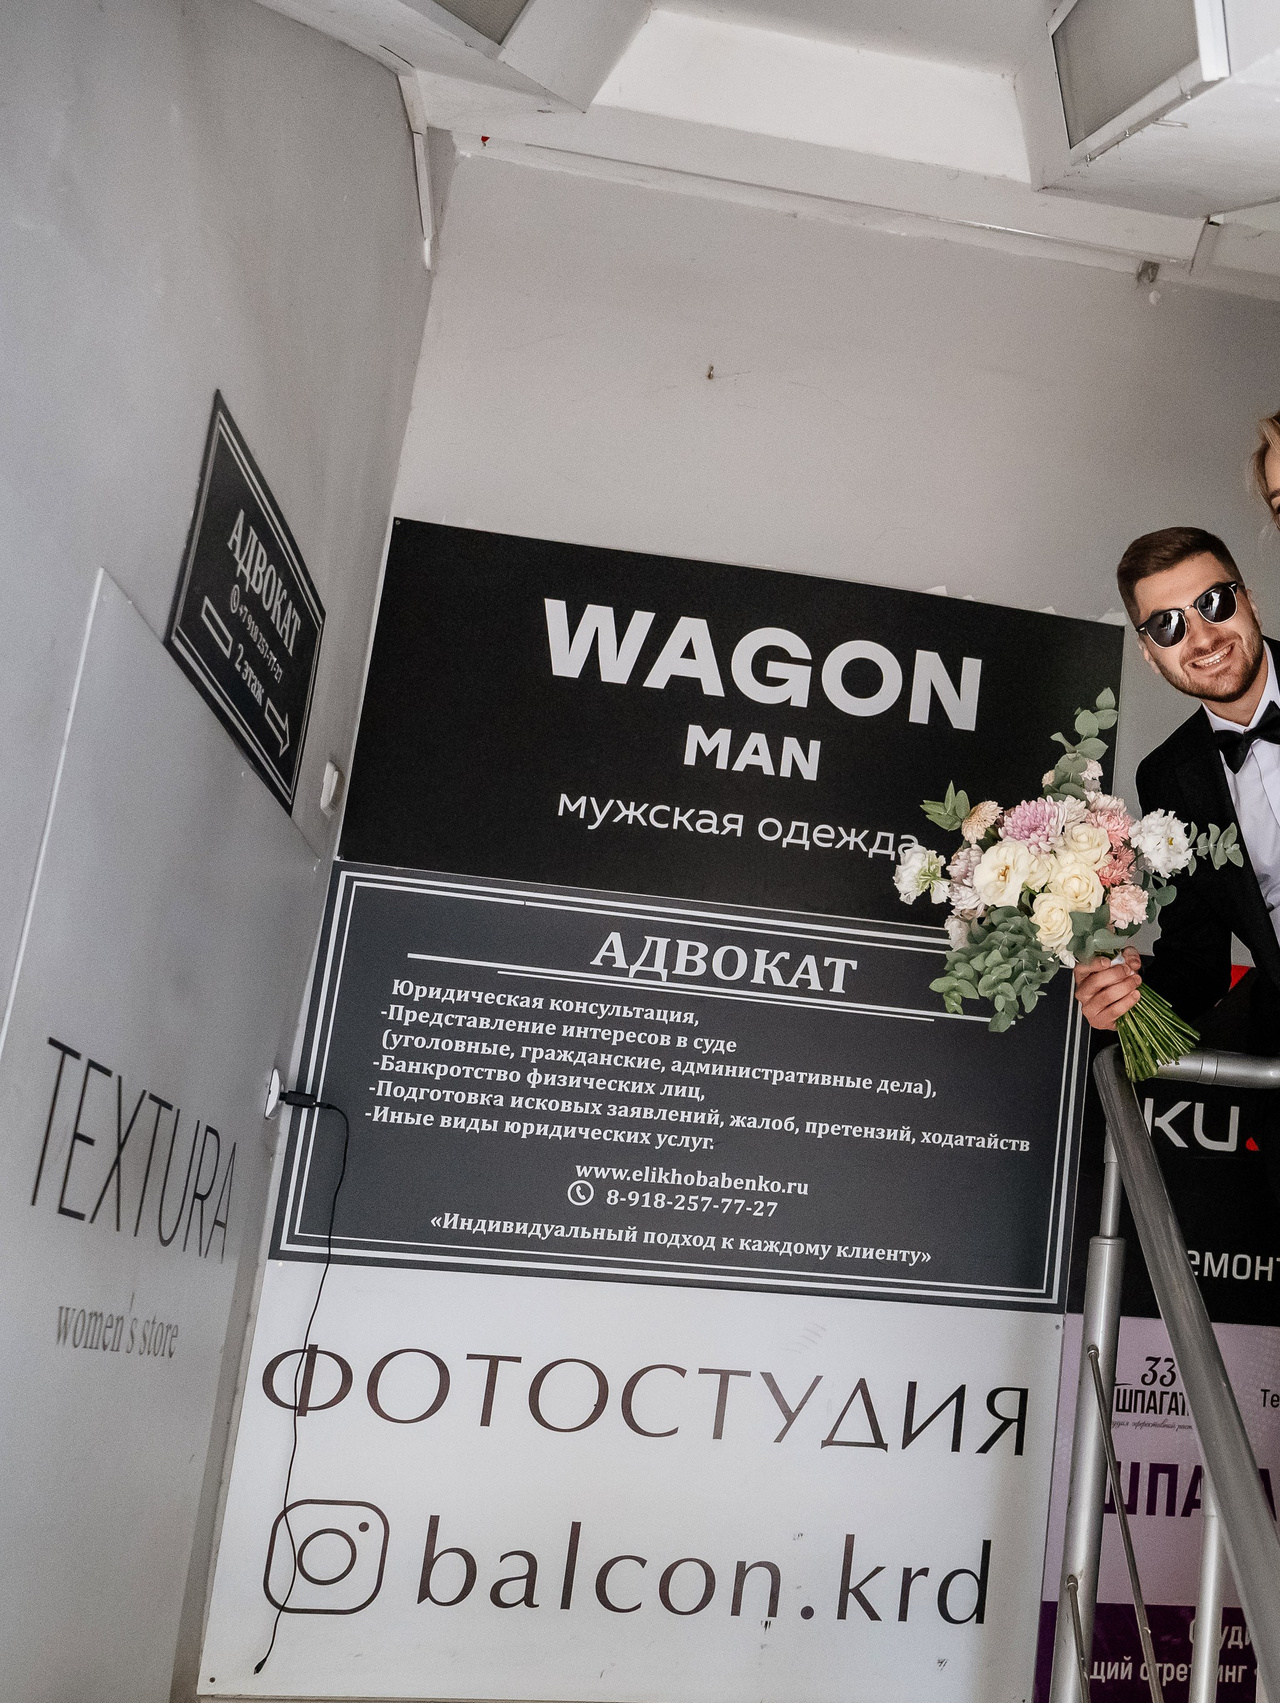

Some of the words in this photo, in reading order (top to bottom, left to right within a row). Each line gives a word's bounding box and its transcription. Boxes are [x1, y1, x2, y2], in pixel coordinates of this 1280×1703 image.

[227, 508, 301, 658] АДВОКАТ
[246, 613, 259, 643] 918
[234, 642, 244, 673] 2
[241, 660, 265, 707] этаж
[543, 597, 983, 732] WAGON
[683, 723, 822, 781] MAN
[558, 793, 745, 838] мужская
[758, 816, 919, 861] одежда
[590, 932, 857, 993] АДВОКАТ
[381, 1004, 556, 1035] -Представление
[562, 1025, 671, 1046] интересов
[676, 1036, 688, 1047] в
[694, 1038, 737, 1054] суде
[392, 979, 544, 1009] Юридическая
[549, 999, 698, 1026] консультация,
[373, 1055, 520, 1082] -Банкротство
[527, 1068, 655, 1094] физических
[660, 1085, 704, 1101] лиц,
[382, 1029, 514, 1059] (уголовные,
[521, 1046, 665, 1072] гражданские,
[671, 1061, 872, 1089] административные
[877, 1079, 936, 1099] дела),
[365, 1106, 434, 1126] -Иные
[440, 1116, 498, 1133] виды
[504, 1121, 651, 1144] юридических
[655, 1134, 714, 1152] услуг.
[369, 1080, 503, 1106] -Подготовка
[510, 1096, 602, 1115] исковых
[607, 1105, 724, 1128] заявлений,
[730, 1115, 799, 1134] жалоб,
[805, 1122, 915, 1144] претензий,
[921, 1132, 1030, 1152] ходатайств
[31, 1036, 238, 1264] TEXTURA
[576, 1165, 808, 1195] www.elikhobabenko.ru
[606, 1190, 778, 1217] 8-918-257-77-27
[431, 1213, 637, 1242] «Индивидуальный
[643, 1232, 715, 1250] подход
[721, 1237, 734, 1249] к
[739, 1239, 832, 1260] каждому
[836, 1246, 931, 1266] клиенту»
[56, 1292, 138, 1355] women's
[138, 1315, 180, 1359] store
[262, 1343, 1030, 1457] ФОТОСТУДИЯ
[1141, 1356, 1177, 1387] 33
[416, 1515, 993, 1625] balcon.krd
